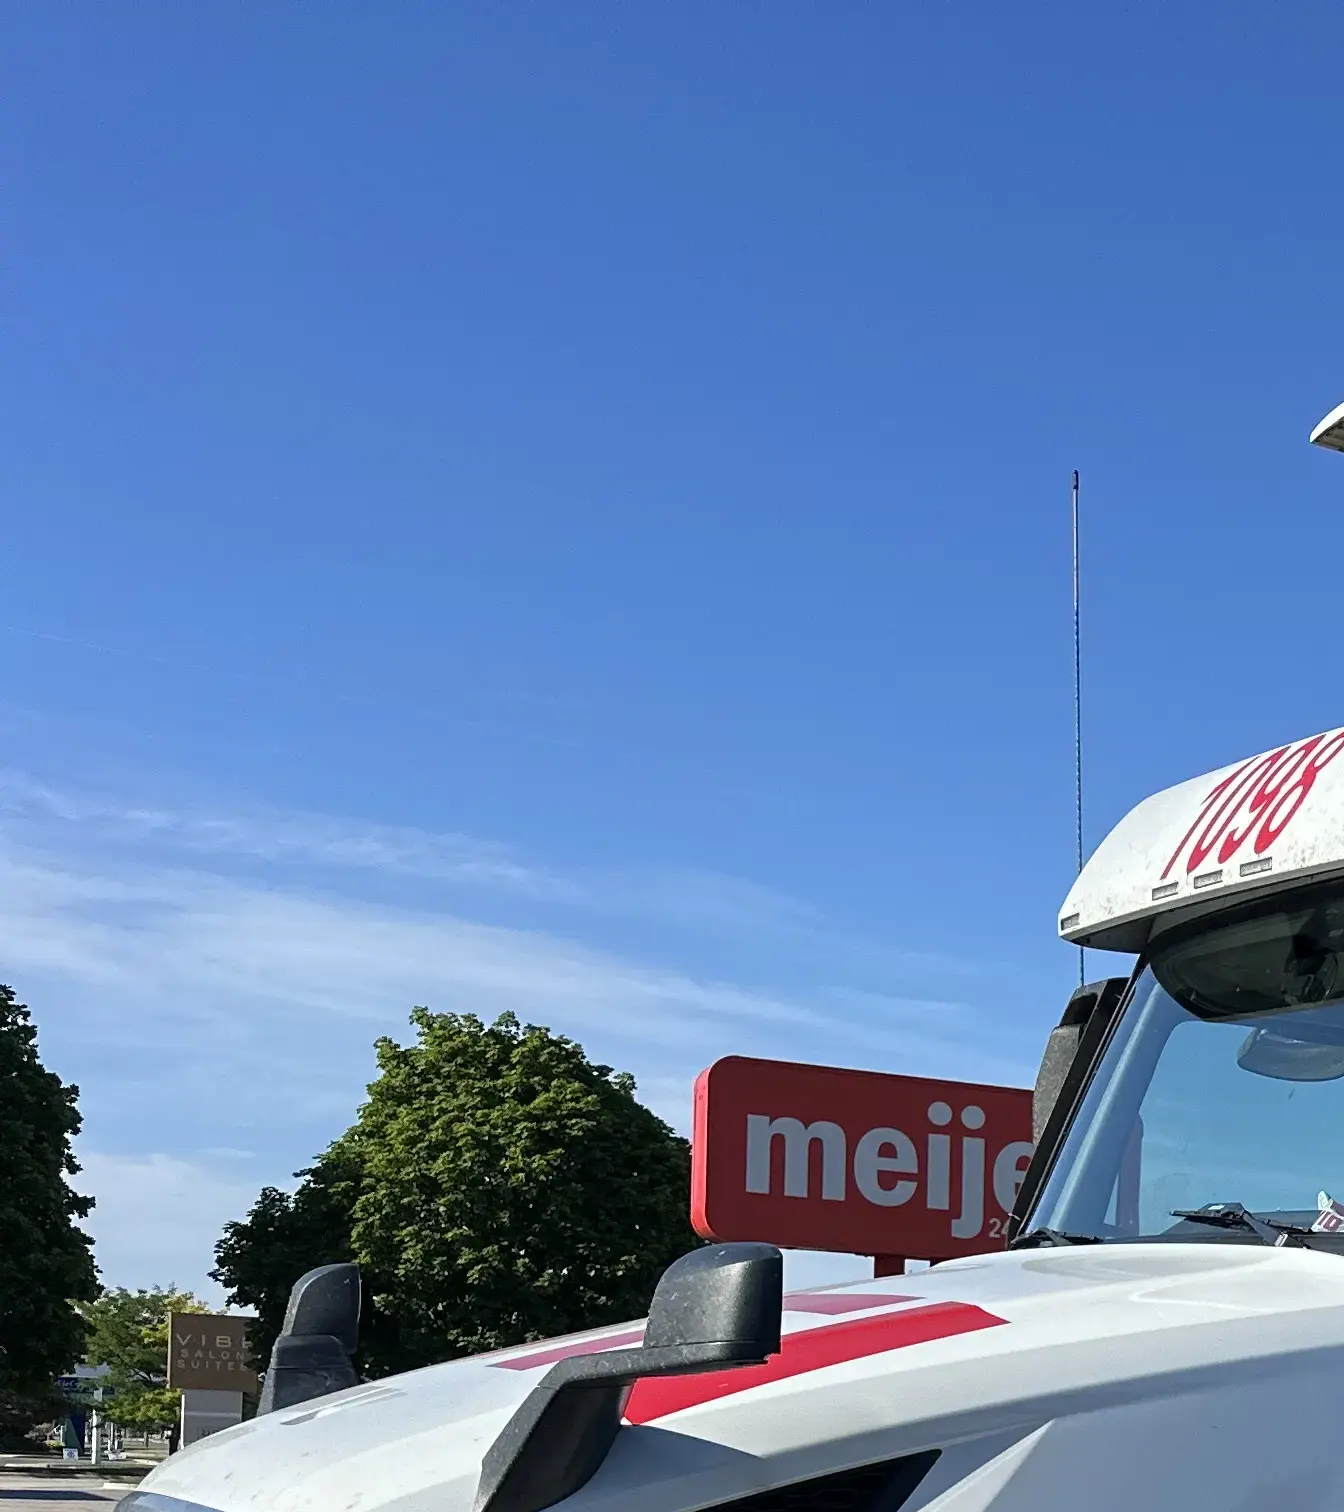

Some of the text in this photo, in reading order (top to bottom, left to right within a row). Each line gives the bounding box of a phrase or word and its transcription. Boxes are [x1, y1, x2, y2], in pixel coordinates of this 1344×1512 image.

[745, 1101, 1038, 1239] meije
[180, 1348, 245, 1360] SALON
[177, 1359, 248, 1371] SUITES
